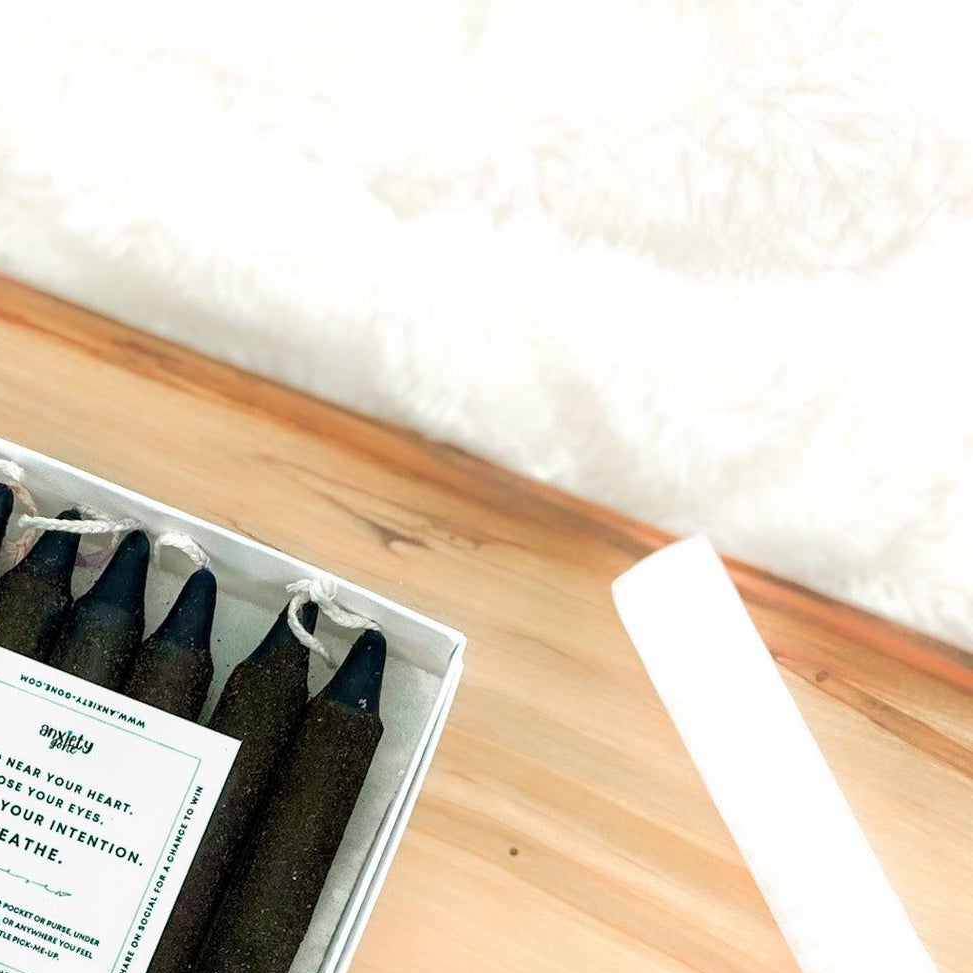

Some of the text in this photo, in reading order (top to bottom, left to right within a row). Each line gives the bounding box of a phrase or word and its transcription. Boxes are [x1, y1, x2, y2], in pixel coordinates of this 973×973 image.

[19, 674, 146, 729] WWW.ANXIETY-GONE.COM
[39, 724, 94, 754] anxiety
[5, 757, 42, 779] NEAR
[46, 772, 83, 795] YOUR
[86, 789, 133, 816] HEART.
[28, 786, 64, 809] YOUR
[67, 803, 104, 825] EYES.
[0, 799, 45, 827] YOUR
[49, 819, 143, 867] INTENTION.
[130, 933, 142, 949] ON
[137, 896, 158, 932] SOCIAL
[153, 874, 167, 894] FOR
[166, 822, 188, 863] CHANCE
[183, 808, 194, 821] TO
[190, 786, 204, 805] WIN
[2, 902, 34, 919] POCKET
[33, 915, 46, 925] OR
[46, 919, 72, 937] PURSE,
[73, 930, 100, 947] UNDER
[2, 916, 15, 927] OR
[14, 922, 59, 945] ANYWHERE
[59, 939, 76, 952] YOU
[75, 946, 93, 960] FEEL
[11, 935, 59, 961] PICK-ME-UP.
